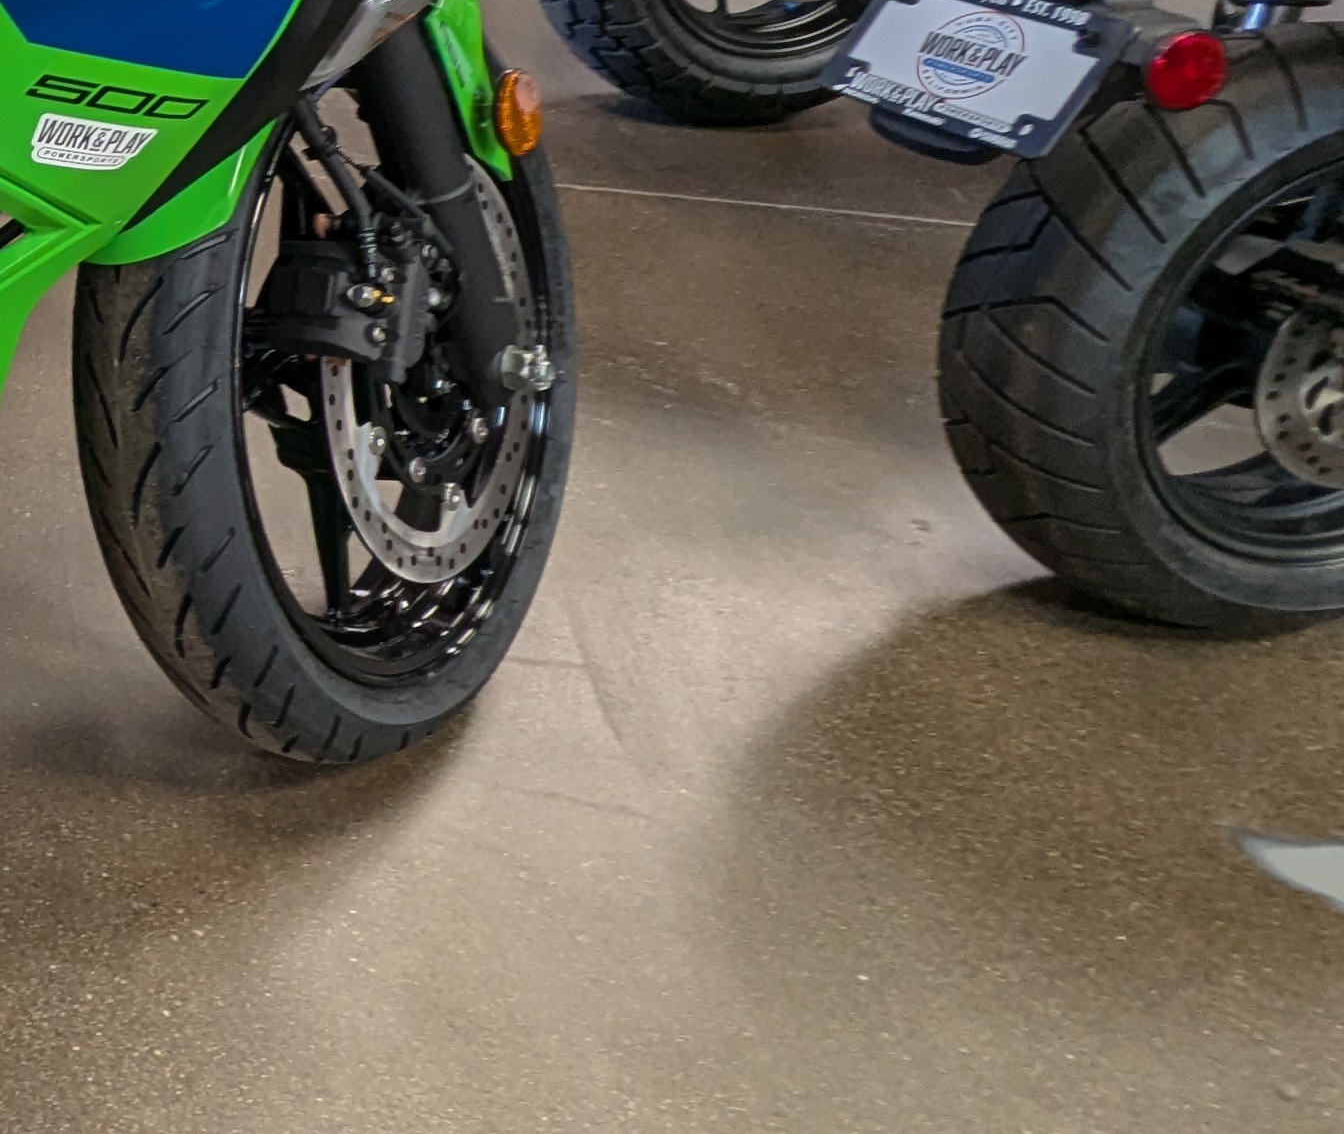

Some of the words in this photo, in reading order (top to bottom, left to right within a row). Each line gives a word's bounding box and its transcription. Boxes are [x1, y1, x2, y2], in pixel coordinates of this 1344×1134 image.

[919, 31, 1029, 78] WORK&PLAY
[25, 74, 210, 119] 500
[43, 149, 120, 164] POWERSPORTS
